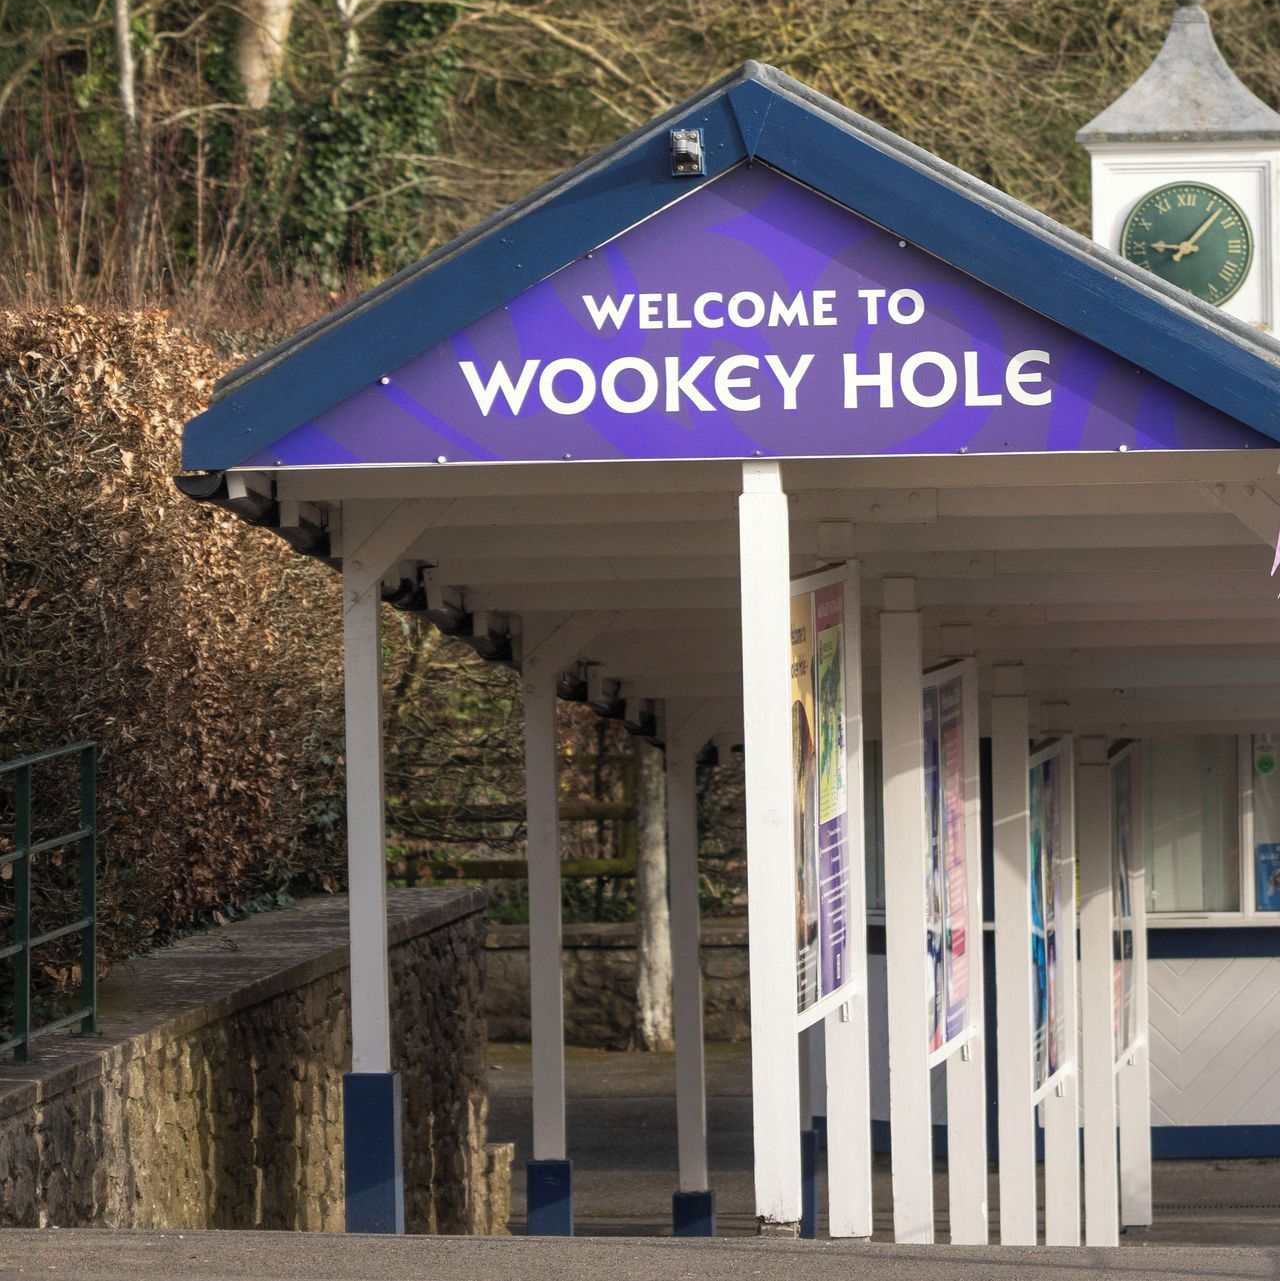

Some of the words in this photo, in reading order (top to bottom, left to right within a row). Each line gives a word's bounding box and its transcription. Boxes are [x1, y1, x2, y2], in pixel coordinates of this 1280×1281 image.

[1177, 194, 1197, 207] XII
[582, 290, 837, 330] WELCOME
[857, 288, 925, 325] TO
[459, 354, 815, 417] WOOKEY
[842, 350, 1052, 409] HOLE
